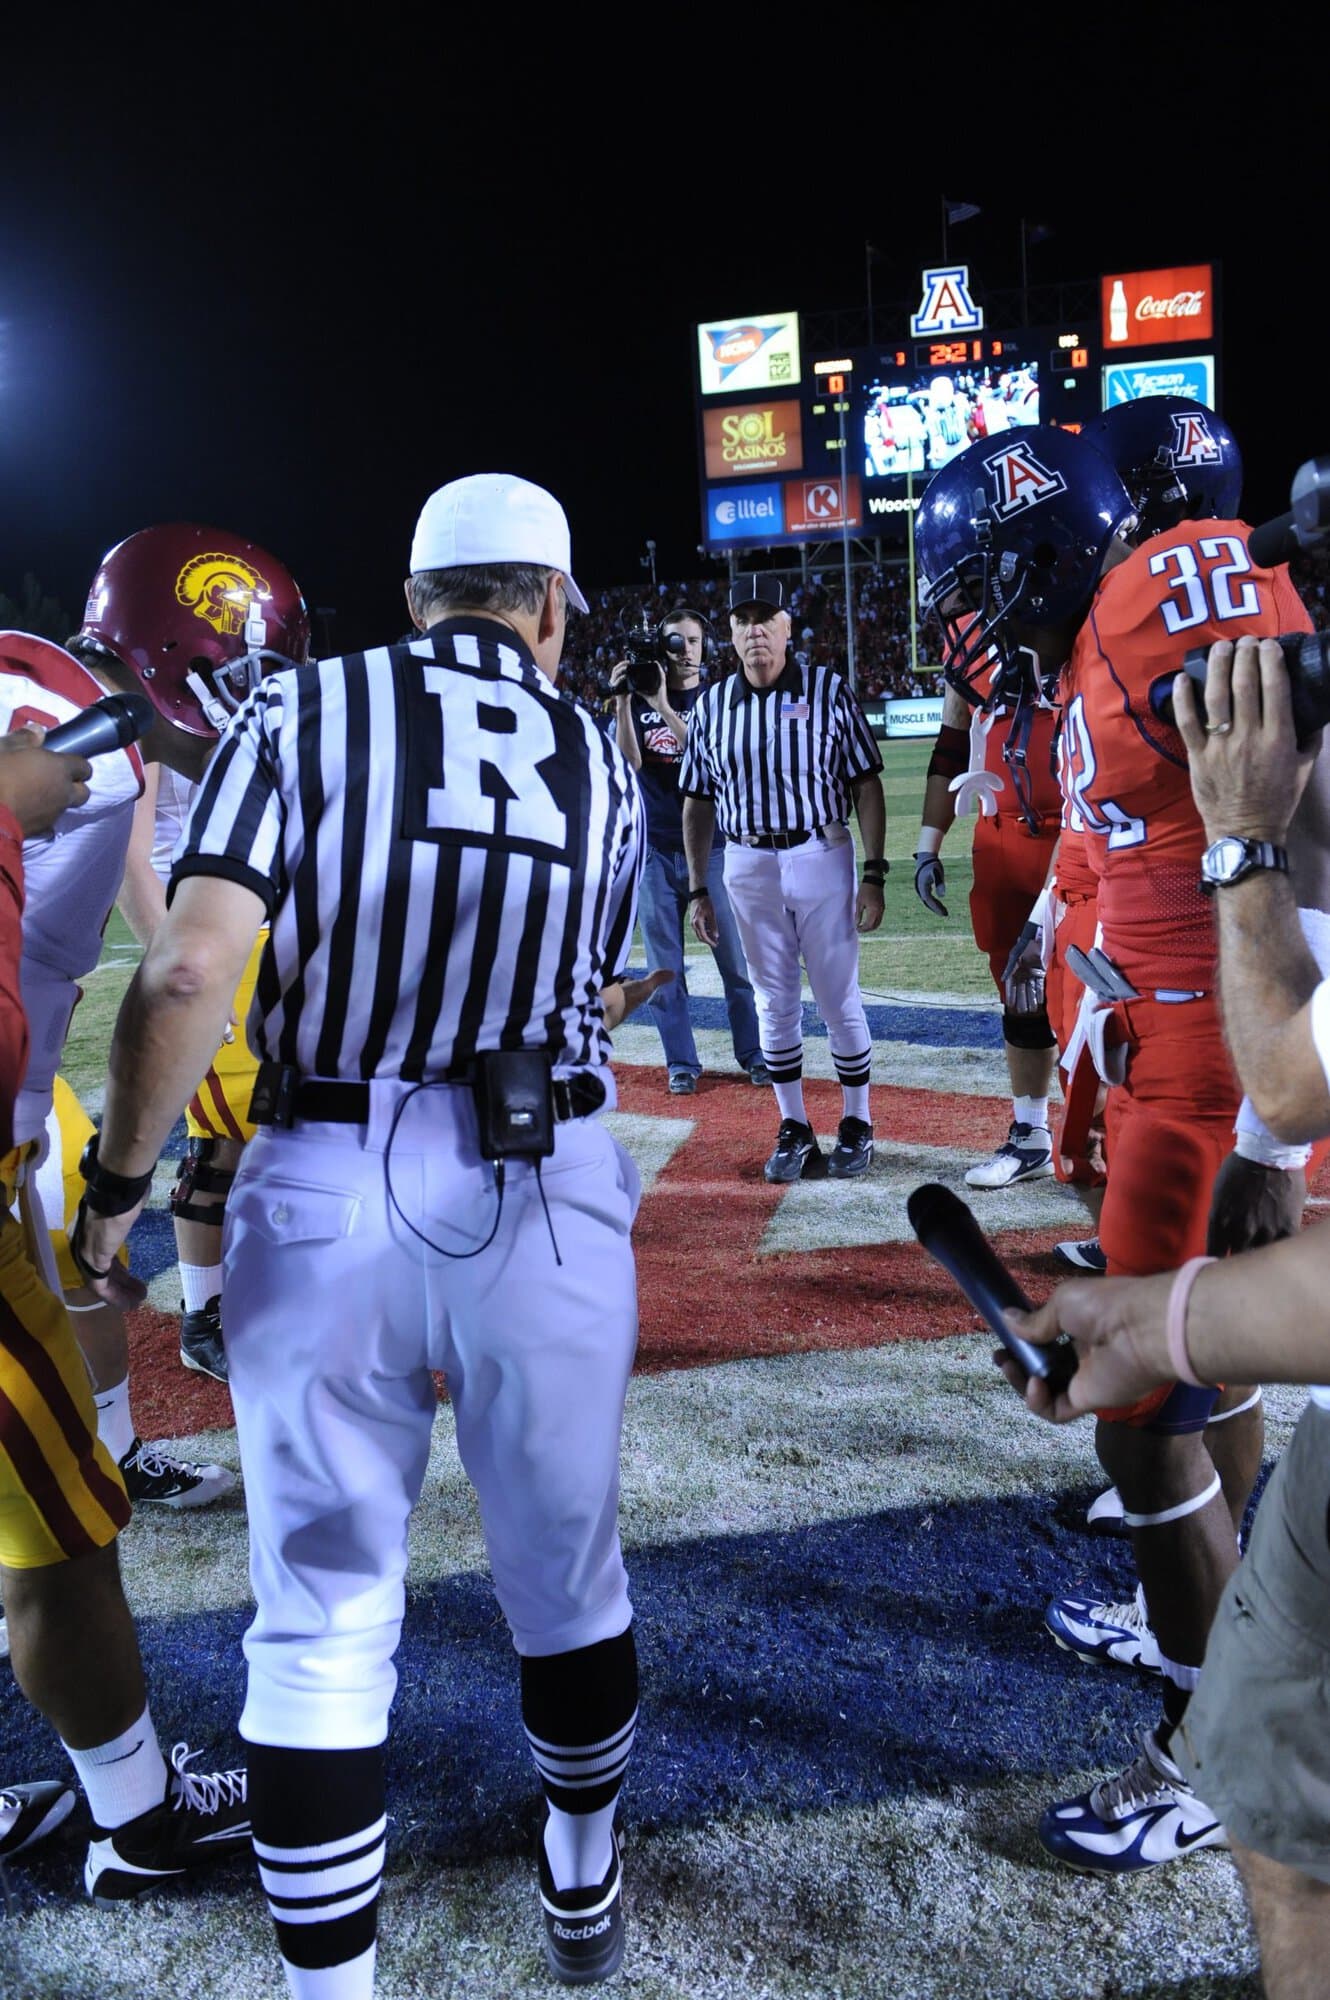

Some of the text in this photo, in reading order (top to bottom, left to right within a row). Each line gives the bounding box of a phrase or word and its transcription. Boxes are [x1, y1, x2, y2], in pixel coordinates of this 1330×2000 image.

[911, 266, 984, 338] A
[929, 340, 982, 367] 2:21
[722, 411, 784, 447] SOL
[1170, 412, 1224, 469] A
[723, 441, 787, 462] CASINOS
[807, 484, 838, 517] K
[983, 441, 1067, 524] A
[1150, 535, 1261, 637] 32
[889, 712, 925, 724] MUSCLE
[927, 712, 943, 722] MIL
[423, 665, 567, 850] R
[553, 1914, 611, 1940] Reebok
